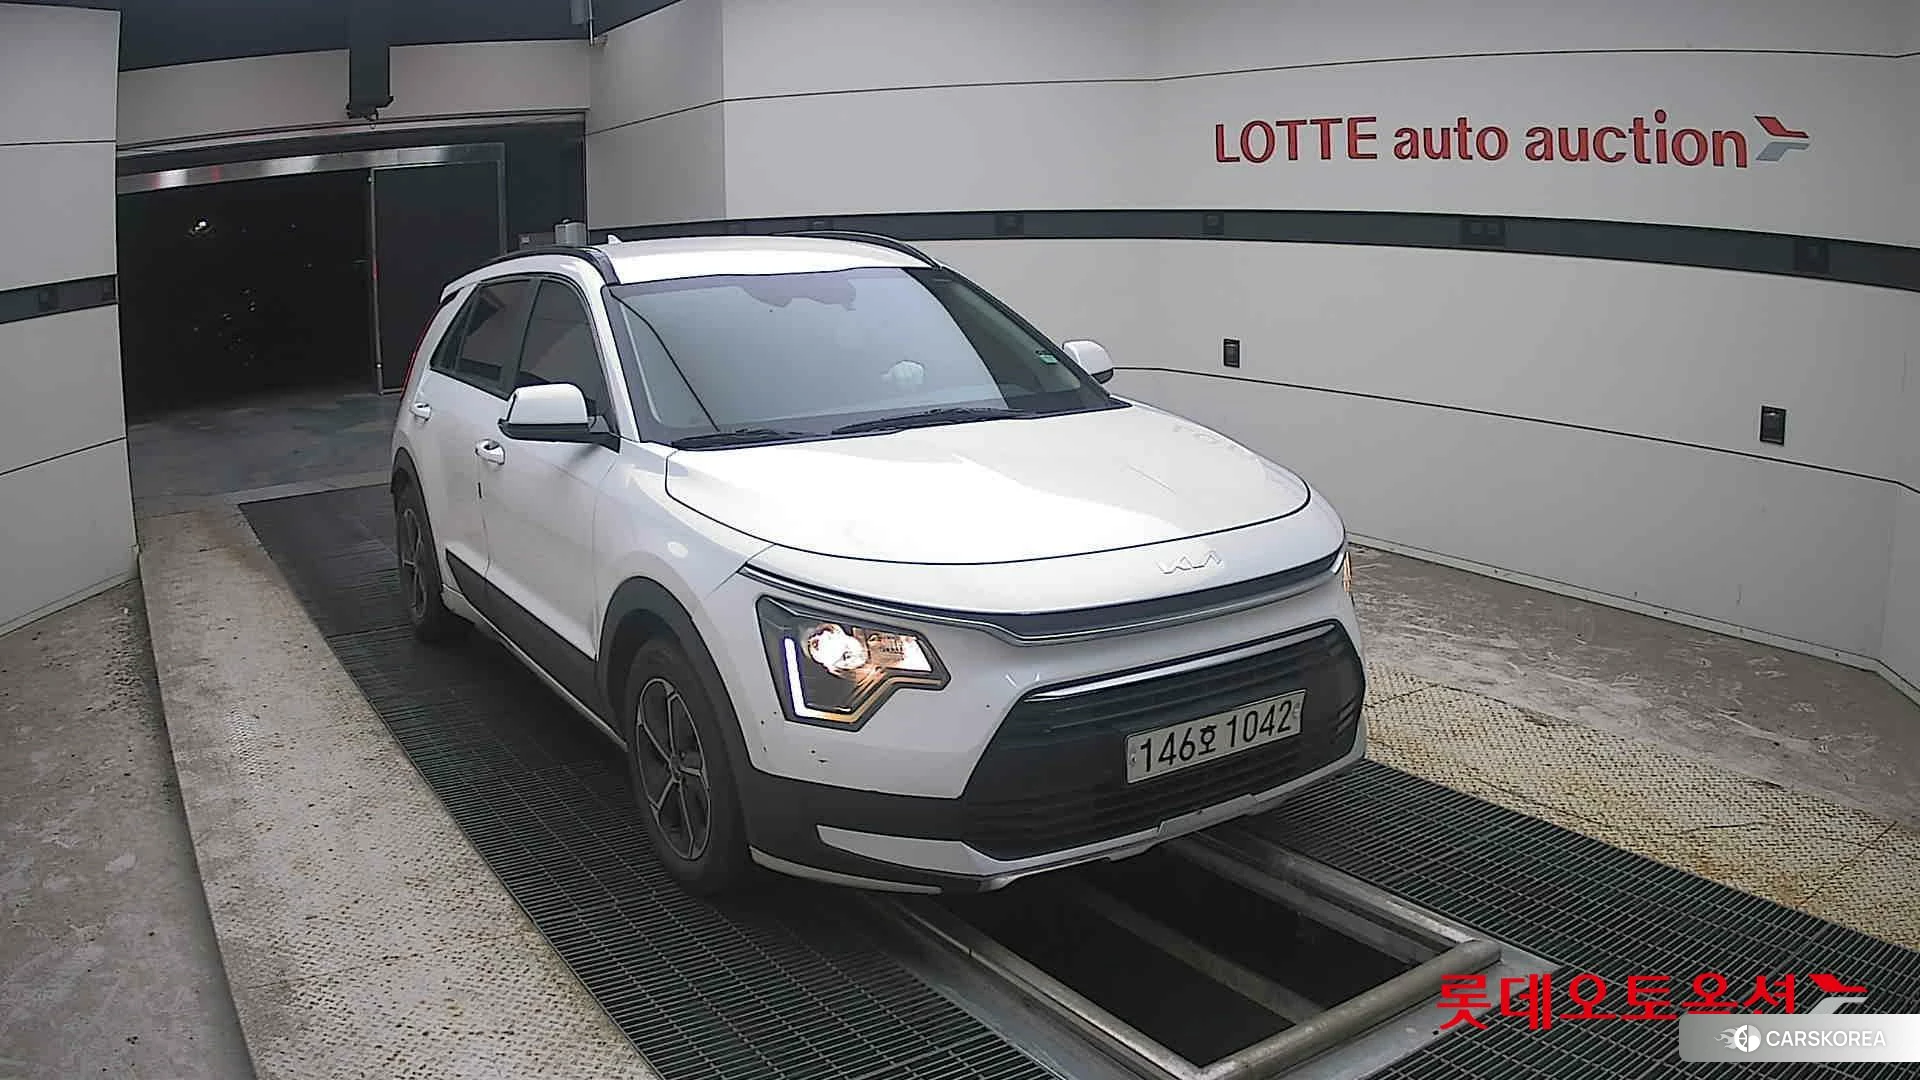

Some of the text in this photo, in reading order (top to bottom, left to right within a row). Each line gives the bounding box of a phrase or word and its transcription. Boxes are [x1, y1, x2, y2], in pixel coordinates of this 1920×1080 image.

[1214, 109, 1748, 168] LOTTE auto auction
[1140, 700, 1292, 772] 146호 1042
